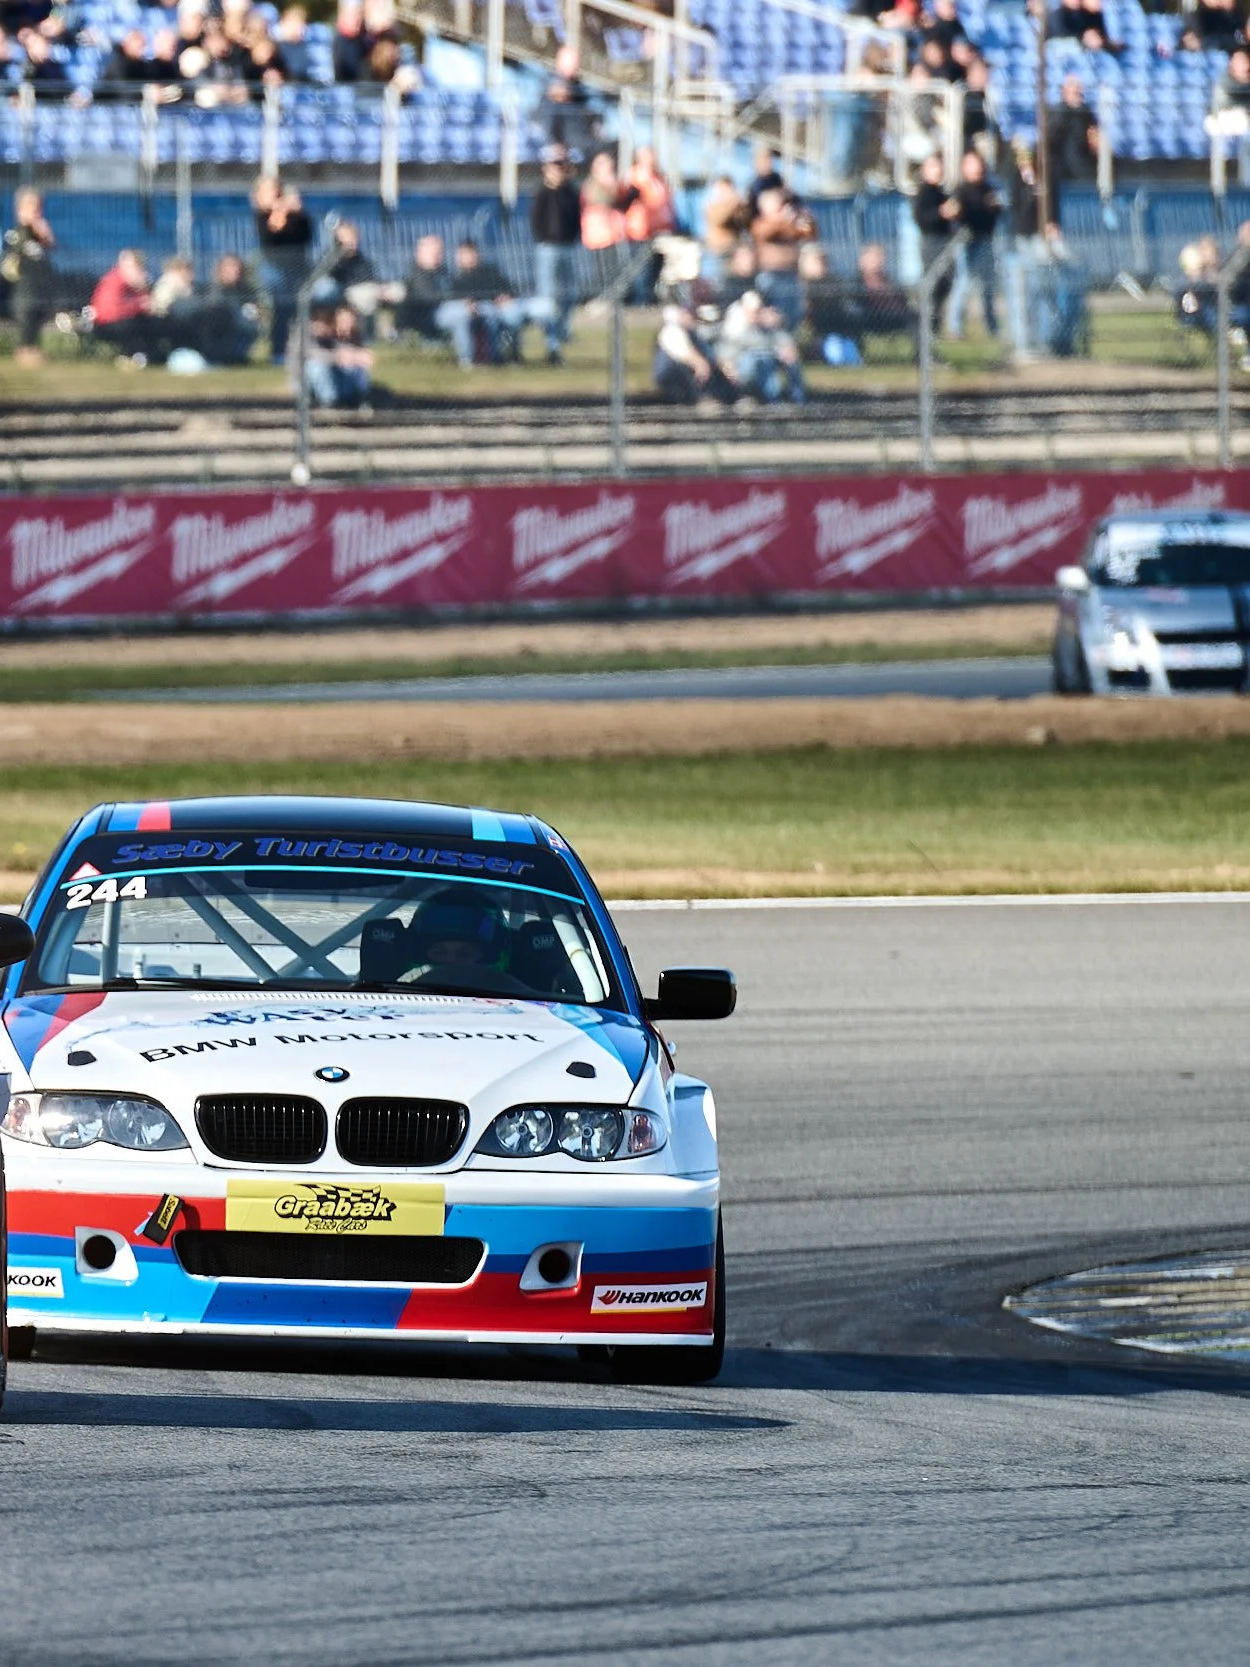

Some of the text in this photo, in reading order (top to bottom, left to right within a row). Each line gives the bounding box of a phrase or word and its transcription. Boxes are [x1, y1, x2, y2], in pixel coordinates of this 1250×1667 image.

[112, 837, 534, 876] Sæby Turistbusser
[65, 876, 148, 908] 244
[139, 1031, 544, 1063] BMW Motorsport
[275, 1194, 397, 1221] Graabæk
